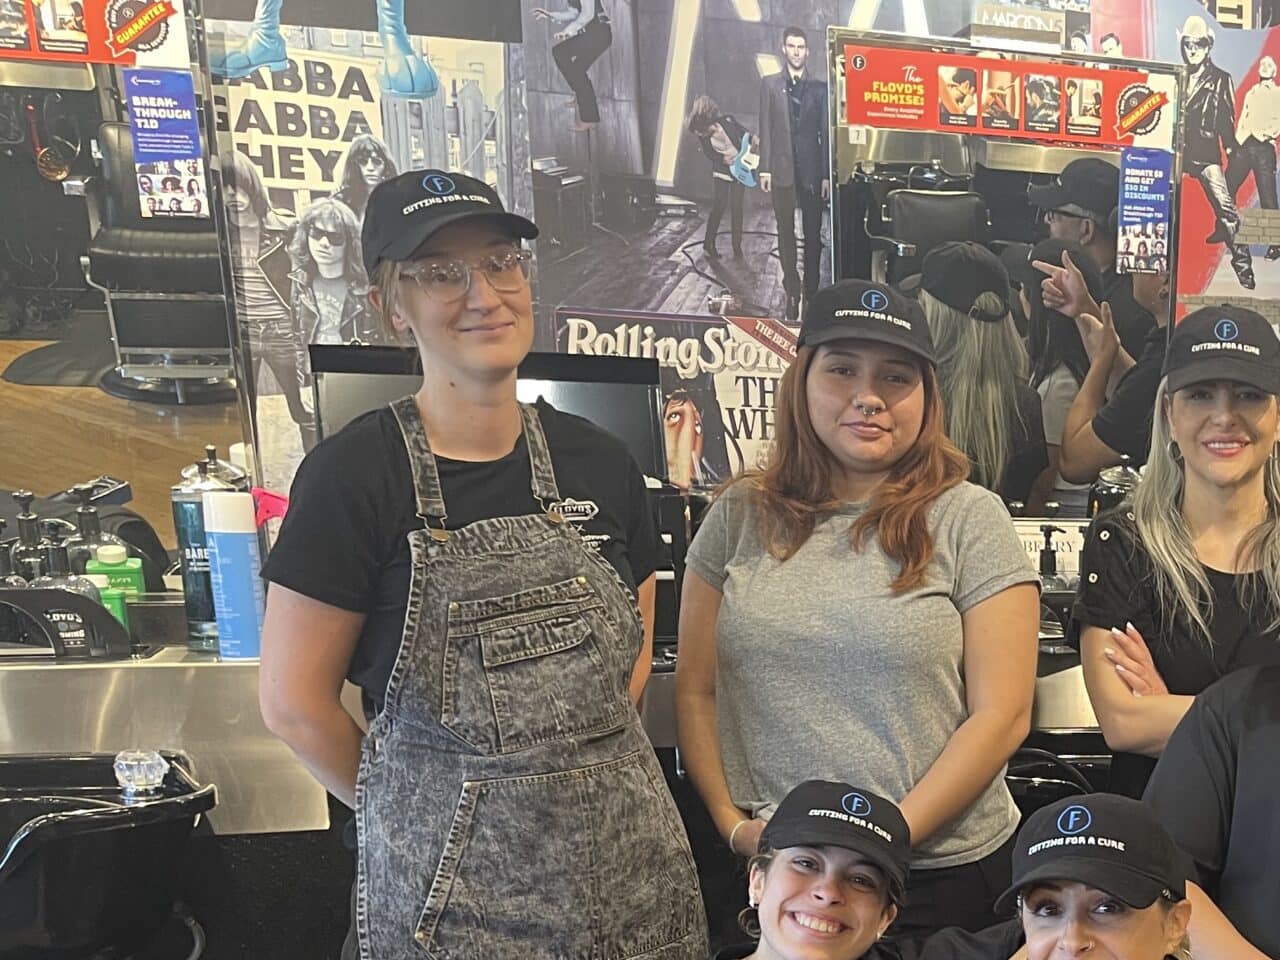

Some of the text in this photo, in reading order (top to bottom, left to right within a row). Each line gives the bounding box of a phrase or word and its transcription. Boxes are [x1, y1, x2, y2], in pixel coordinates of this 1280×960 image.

[116, 3, 167, 44] GUARANTEE
[873, 81, 924, 95] FLOYD'S
[864, 92, 924, 106] PROMISE:
[133, 108, 192, 119] THROUGH
[236, 143, 343, 183] HEY
[403, 196, 442, 215] CUTTING
[442, 194, 461, 203] FOR
[835, 309, 869, 317] CUTTING
[870, 311, 886, 320] FOR
[755, 319, 774, 339] THE
[566, 318, 786, 379] Rolling Ston
[1191, 342, 1221, 353] CUTTING
[1222, 342, 1237, 350] FOR
[1237, 343, 1243, 351] A
[734, 375, 780, 408] TH
[725, 407, 778, 441] WH
[808, 809, 892, 842] CUTTING FOR A CURE
[1028, 836, 1126, 856] CUTTING FOR A CURE
